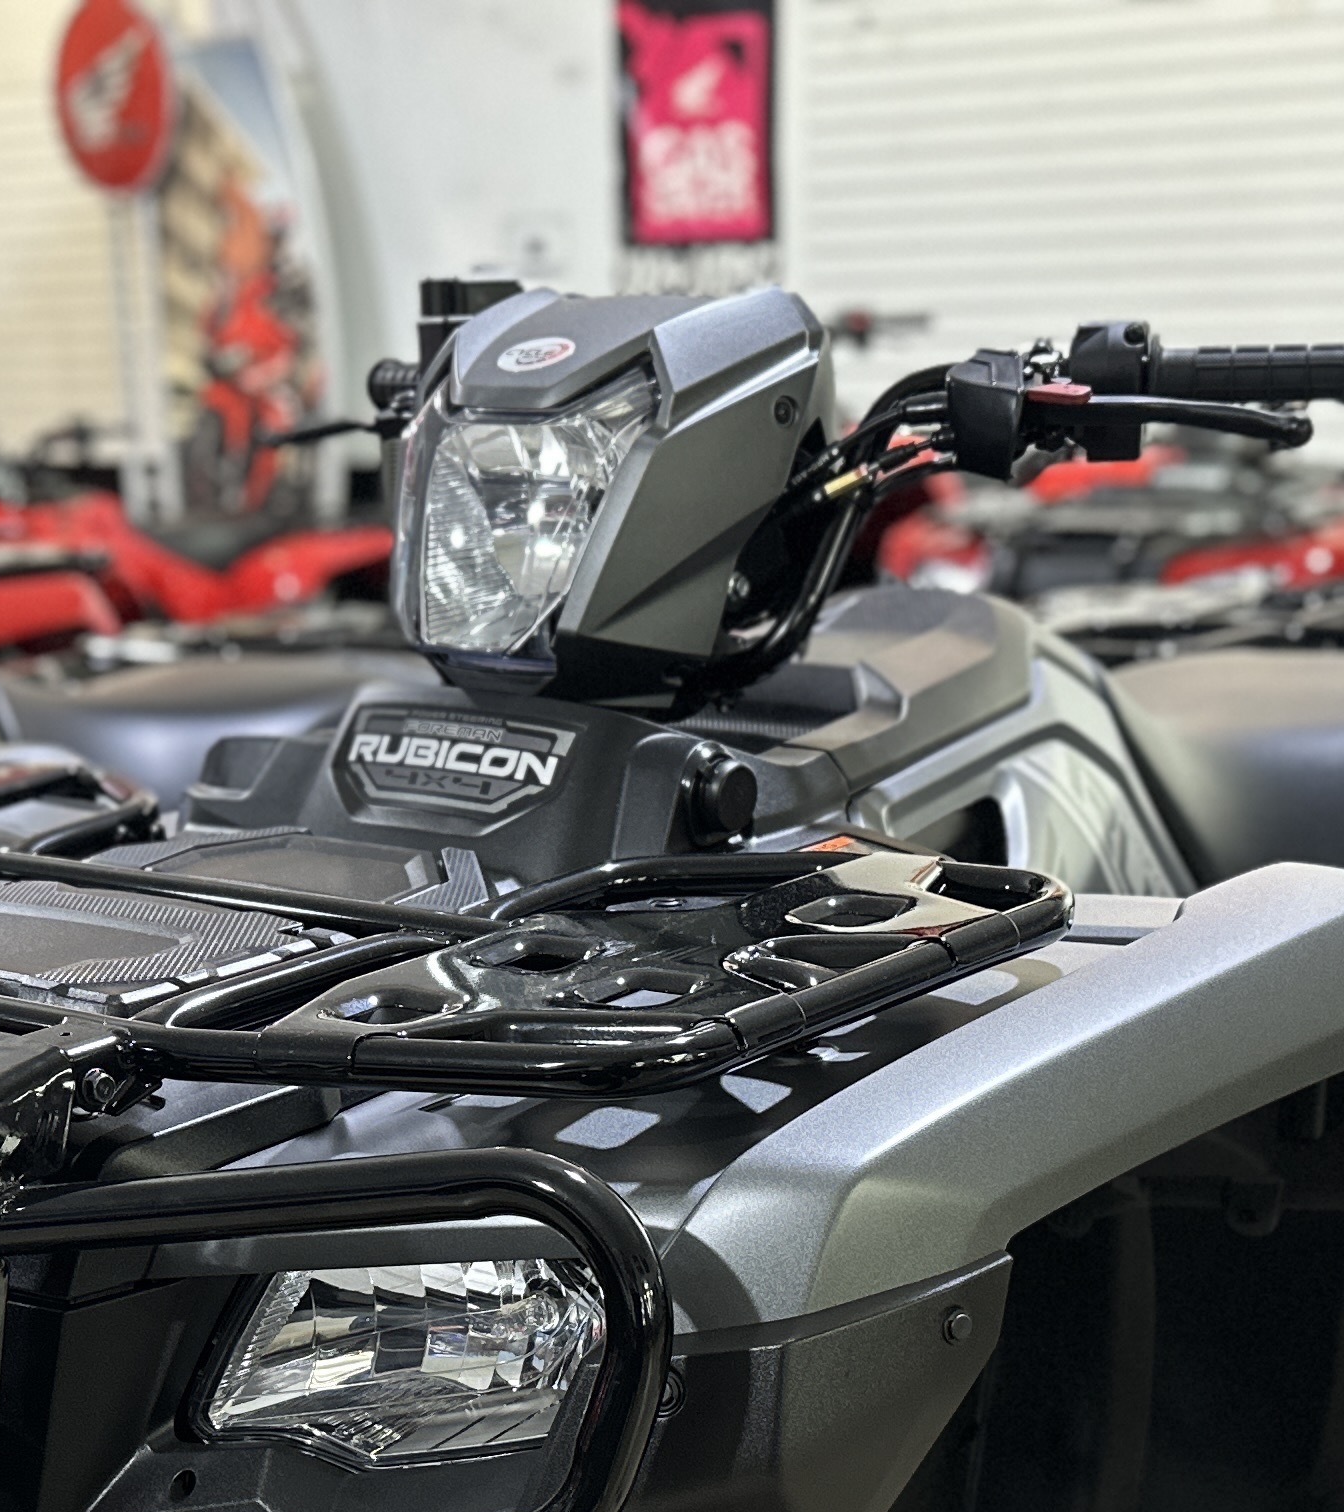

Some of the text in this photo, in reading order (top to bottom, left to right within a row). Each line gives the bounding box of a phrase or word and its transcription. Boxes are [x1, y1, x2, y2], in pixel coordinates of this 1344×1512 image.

[410, 709, 504, 726] POWER STEERING
[404, 719, 502, 744] FOREMAN
[348, 733, 559, 786] RUBICON
